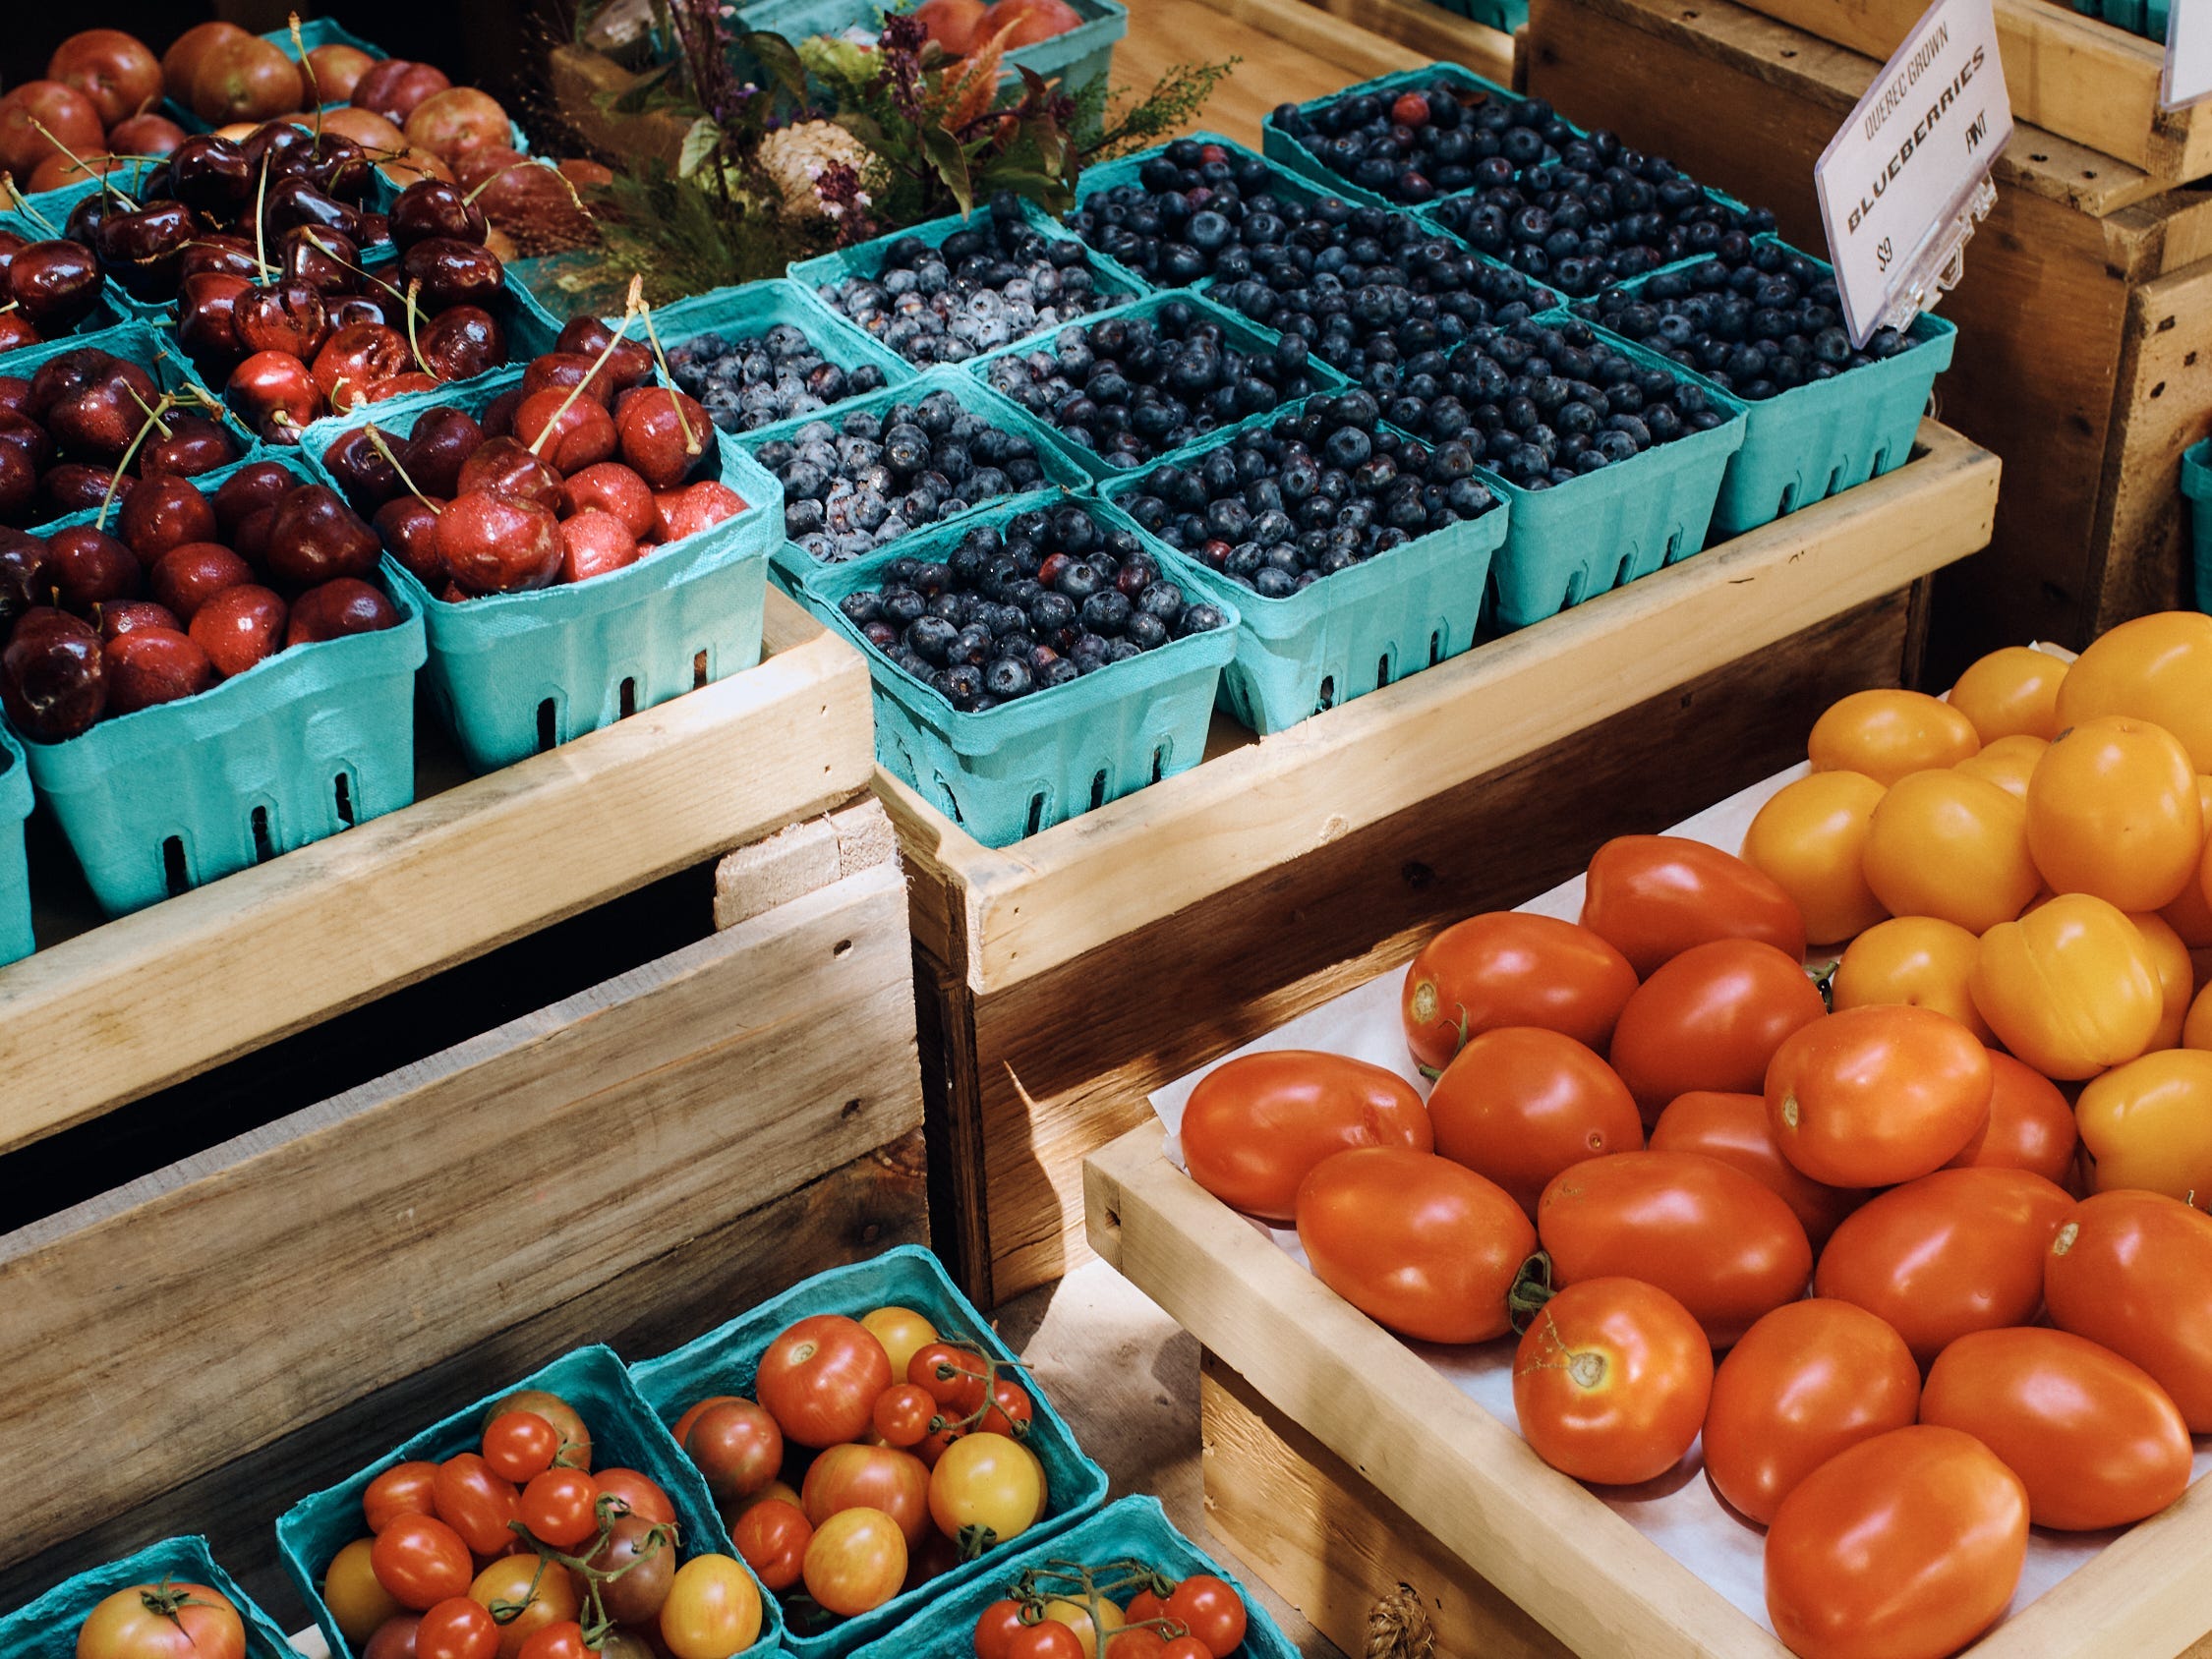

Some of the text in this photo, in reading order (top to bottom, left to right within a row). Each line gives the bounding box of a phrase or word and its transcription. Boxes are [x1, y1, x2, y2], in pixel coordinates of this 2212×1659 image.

[1847, 44, 1986, 236] BLUEBERRIES
[1864, 21, 1949, 142] QUEBEC GROWN
[1876, 108, 1988, 273] $9 PINT
